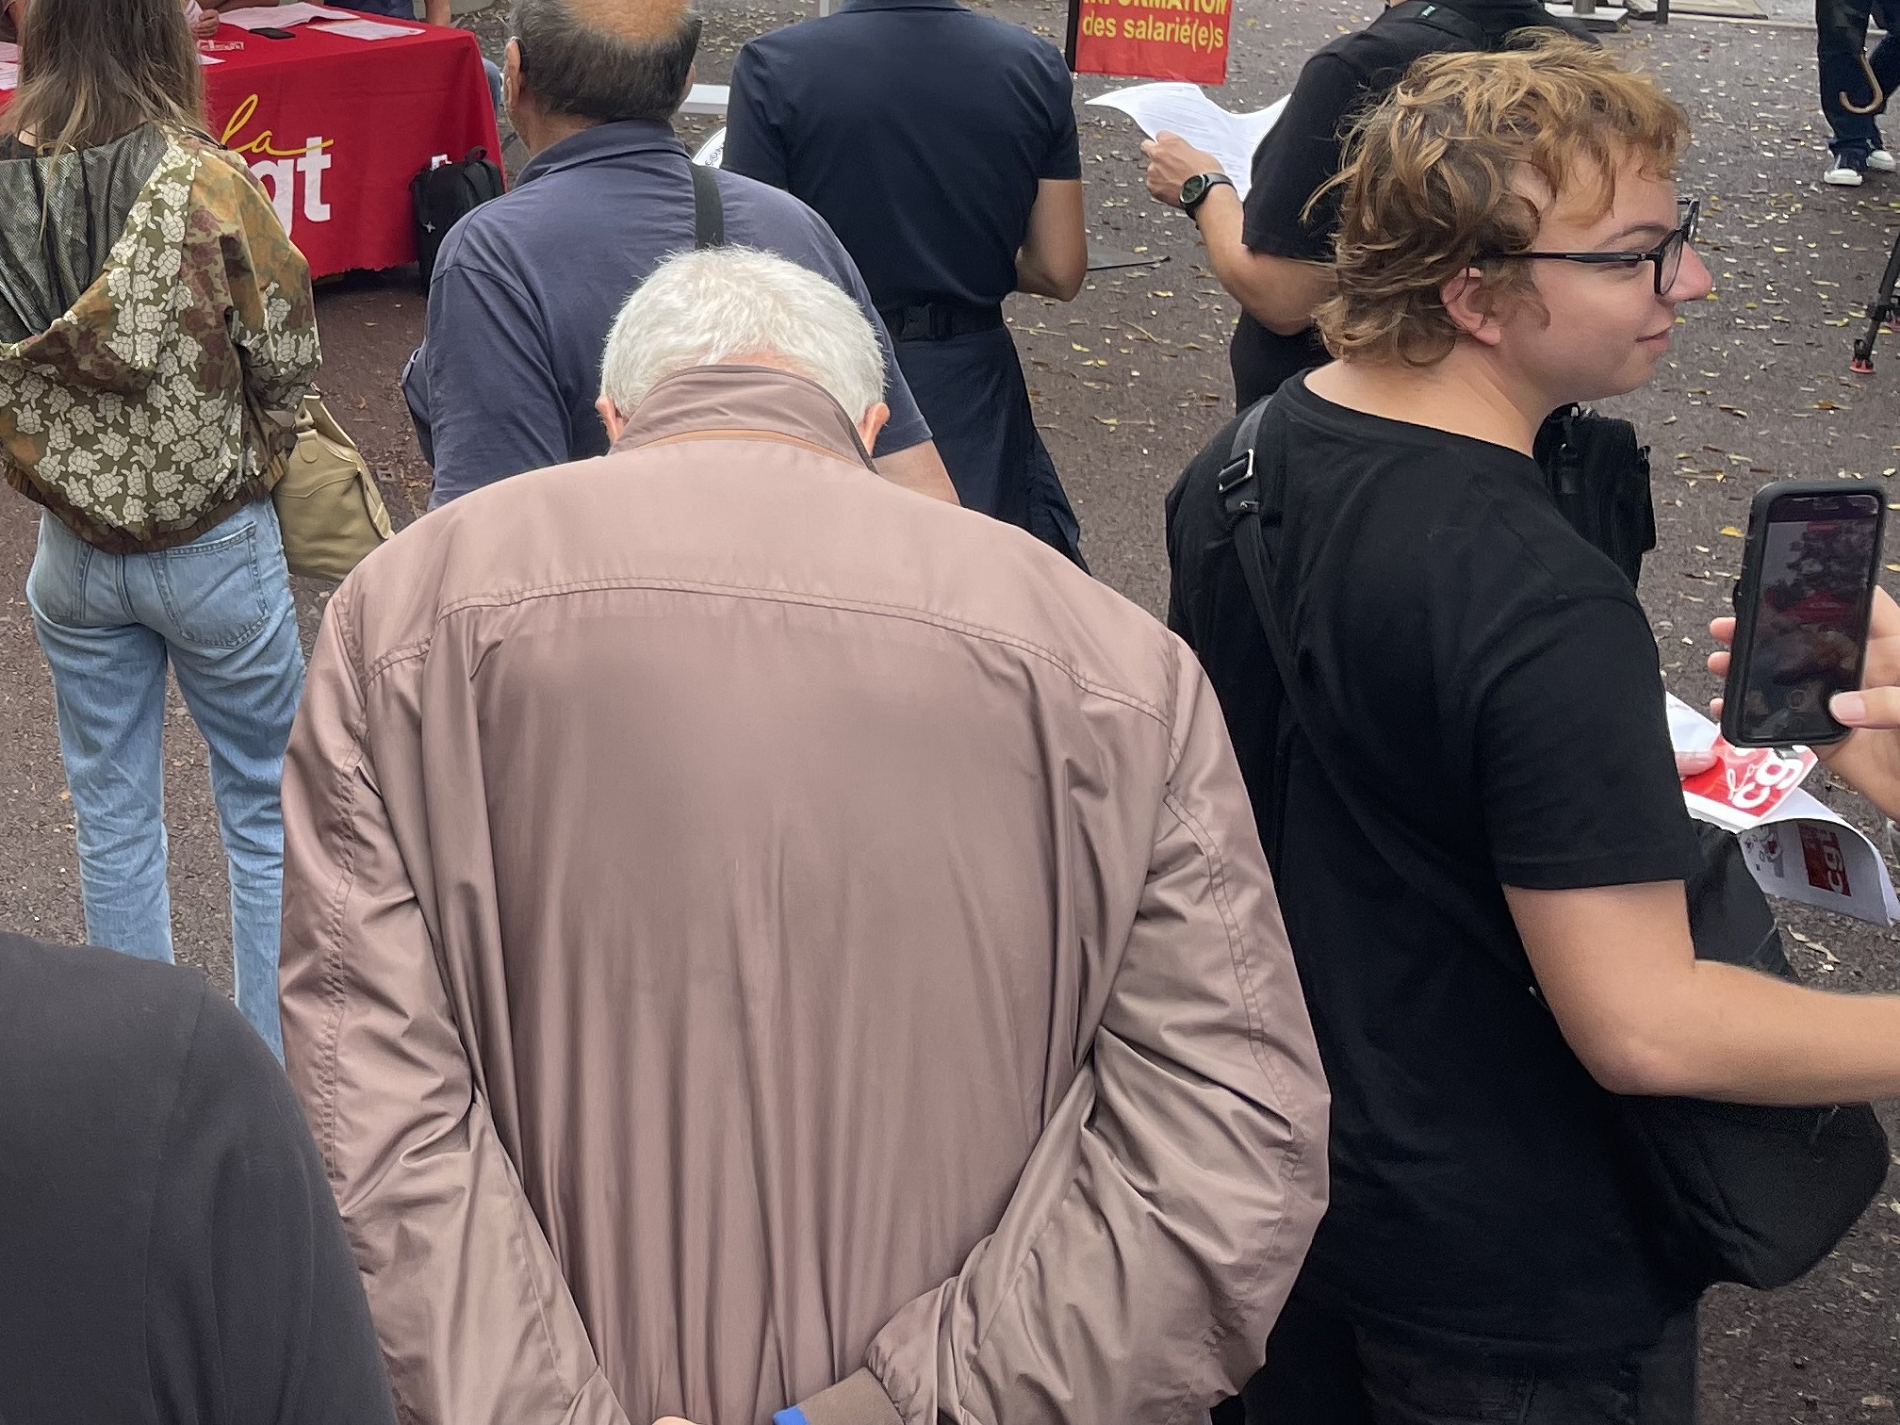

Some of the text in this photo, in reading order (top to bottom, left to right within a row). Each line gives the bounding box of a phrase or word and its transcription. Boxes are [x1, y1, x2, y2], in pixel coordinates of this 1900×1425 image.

[1082, 10, 1224, 54] des salarié(e)s
[220, 93, 334, 156] la
[250, 136, 332, 239] gt
